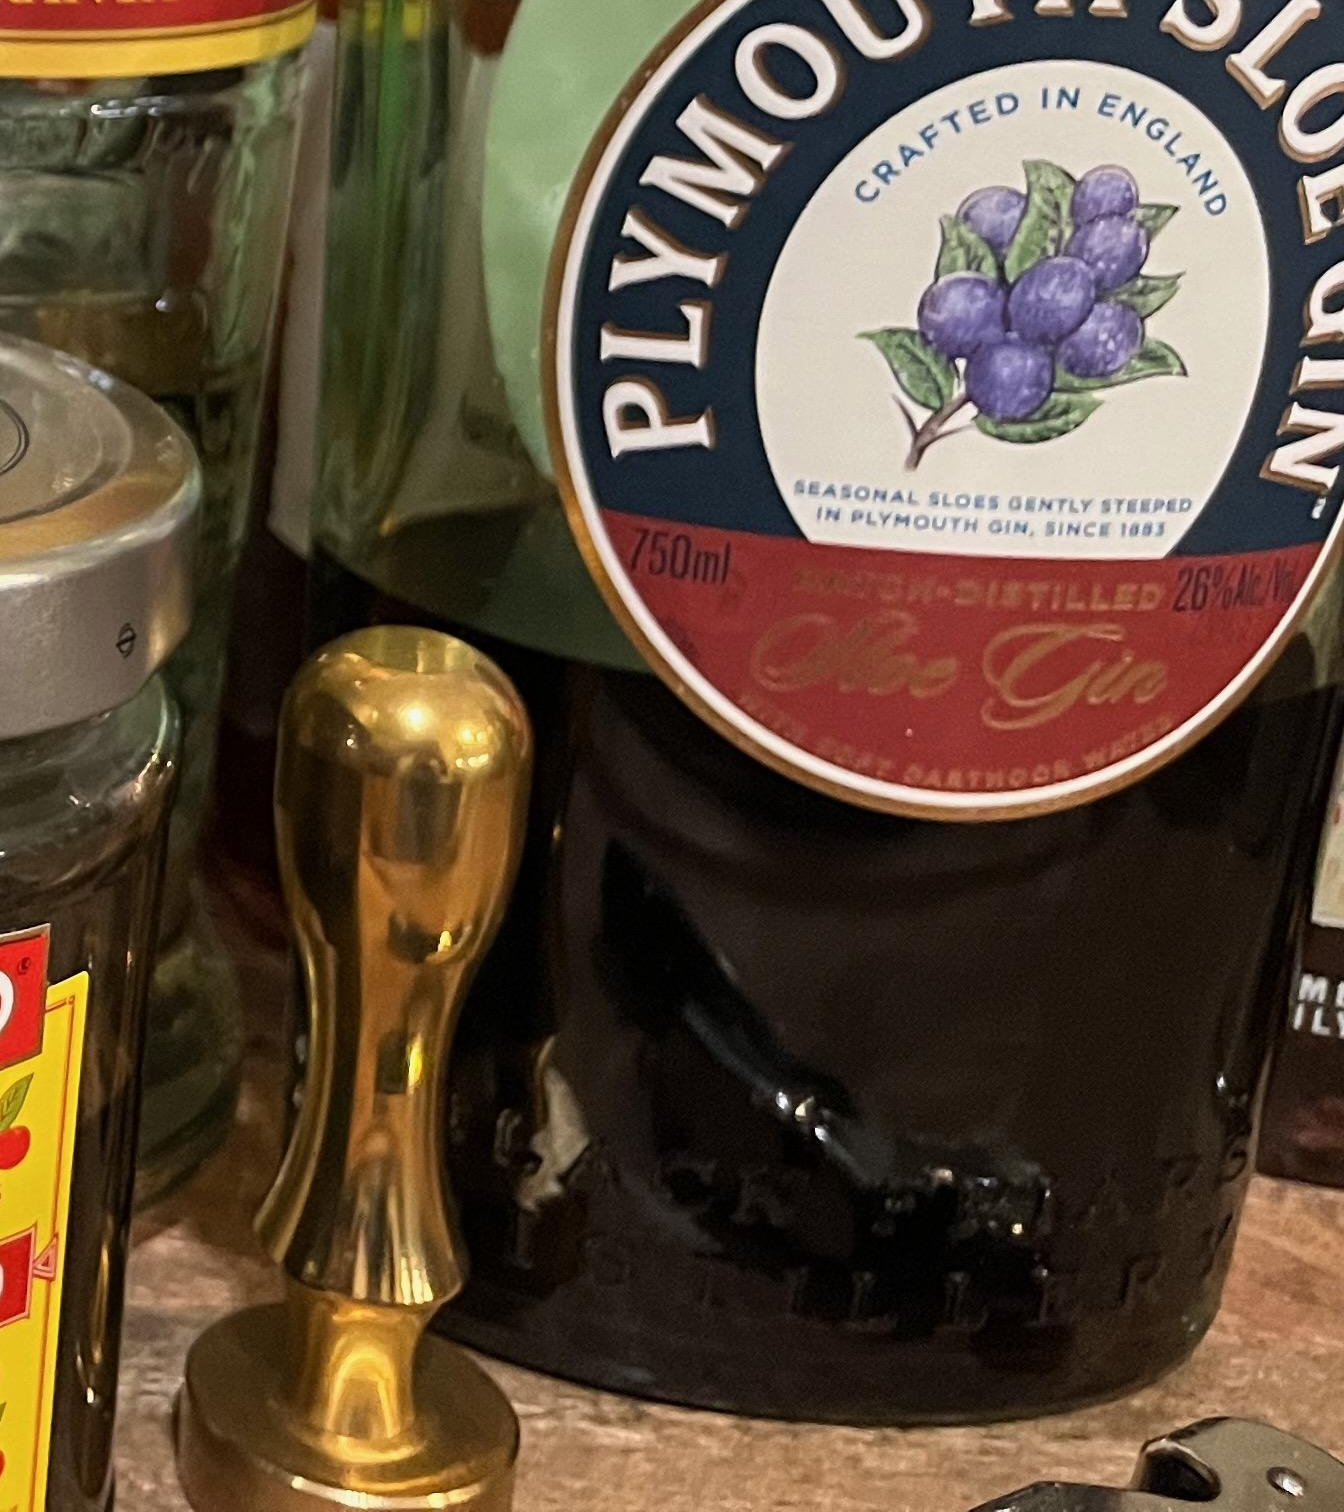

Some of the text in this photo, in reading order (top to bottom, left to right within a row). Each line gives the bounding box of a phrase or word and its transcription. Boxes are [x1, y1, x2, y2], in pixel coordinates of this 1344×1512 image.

[854, 87, 1228, 217] CRAFTED IN ENGLAND
[794, 479, 1193, 514] SEASONAL SLOES GENTLY STEEPED
[816, 506, 841, 522] IN
[850, 509, 979, 534] PLYMOUTH
[1045, 520, 1111, 537] SINCE
[630, 528, 731, 583] 750ml
[979, 621, 1169, 731] Gin
